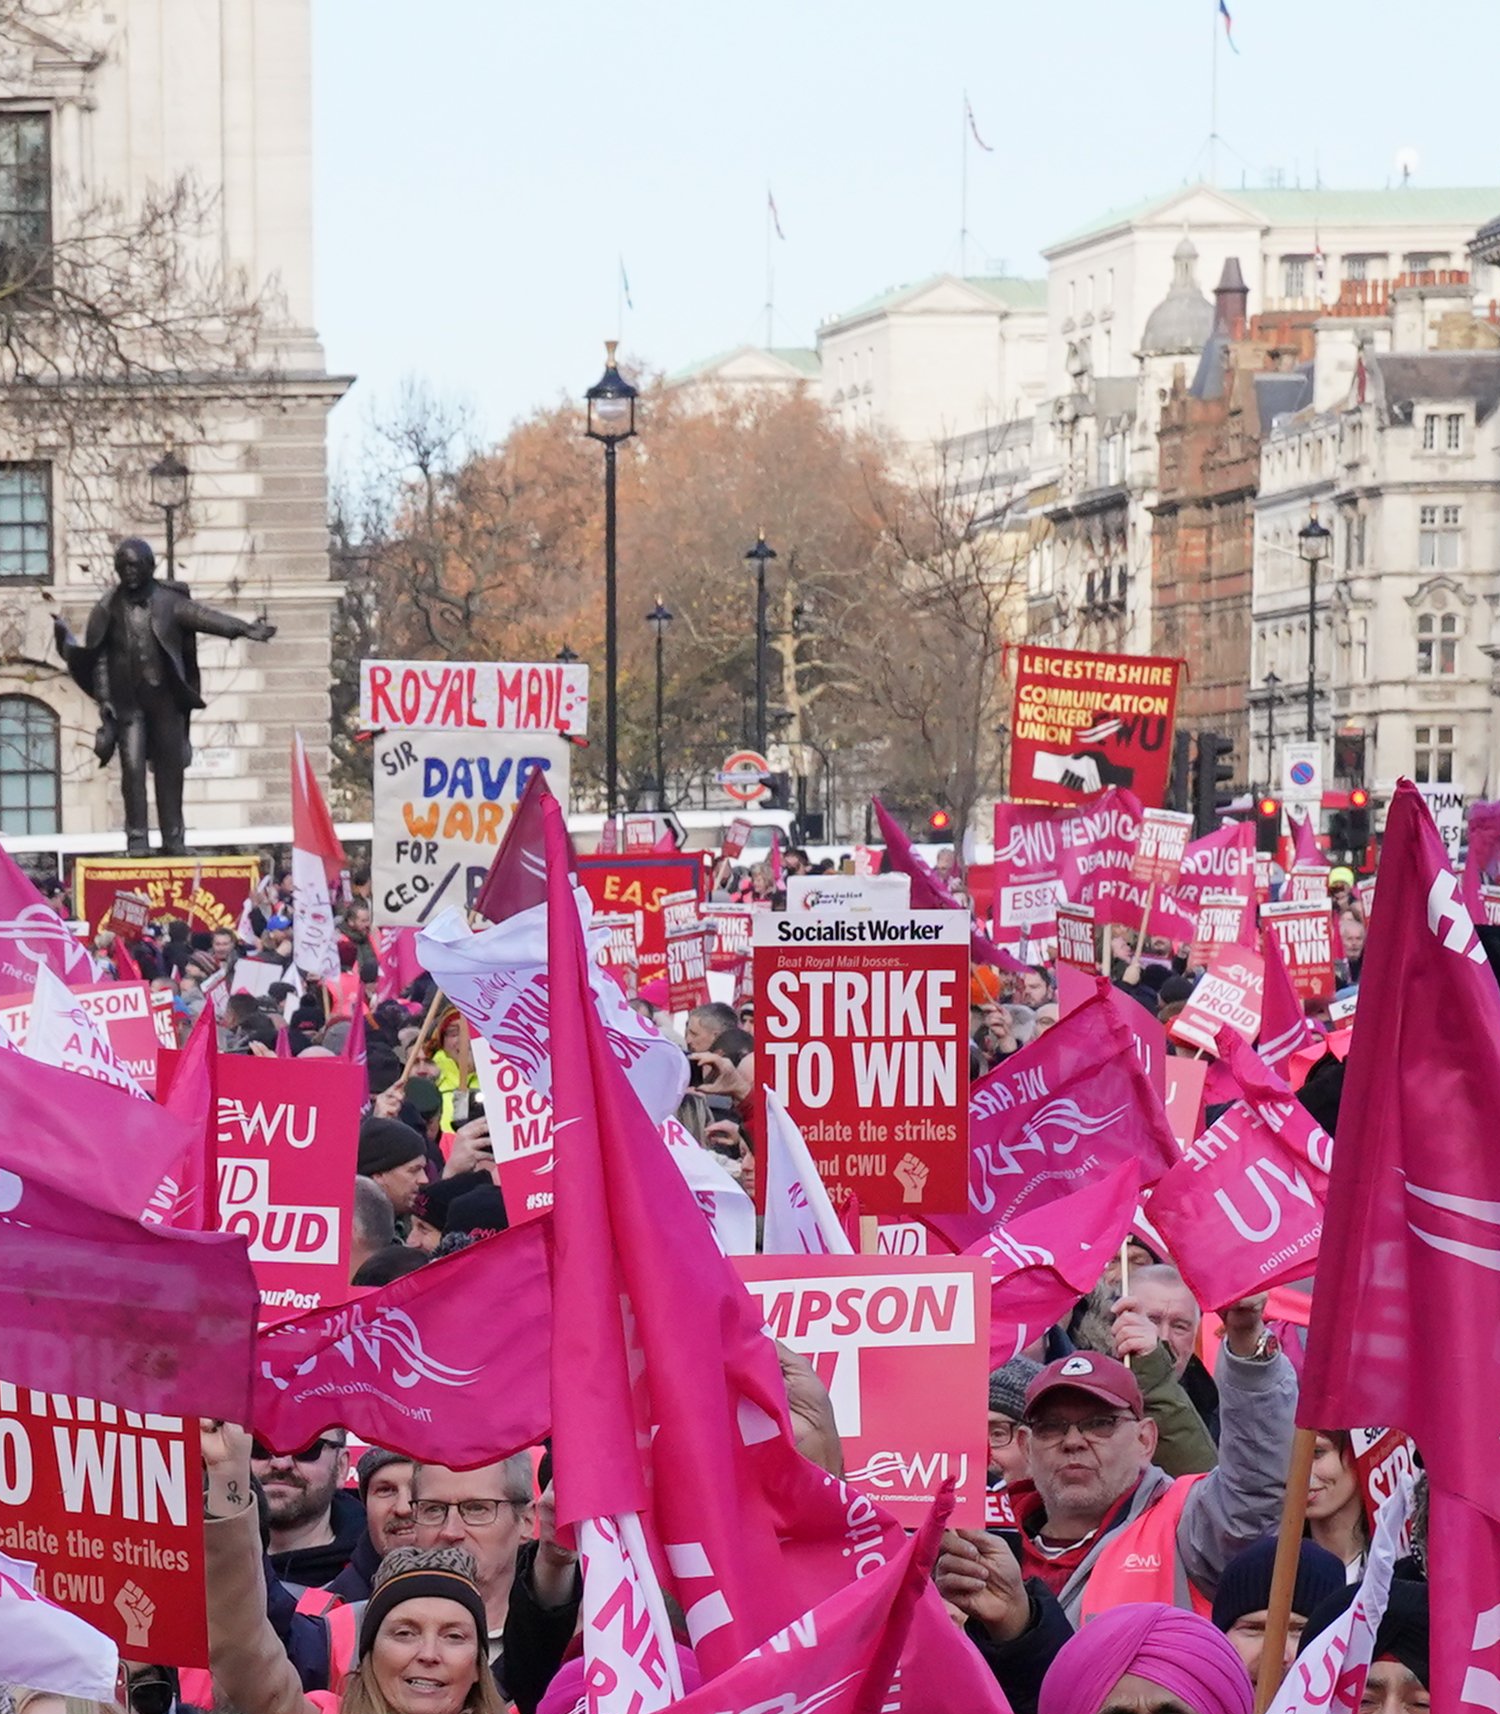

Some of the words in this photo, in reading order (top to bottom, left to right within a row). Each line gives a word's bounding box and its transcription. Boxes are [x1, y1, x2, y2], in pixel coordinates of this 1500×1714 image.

[1023, 656, 1173, 686] LEICESTERSHIRE
[369, 665, 486, 728] ROYAL
[497, 667, 571, 730] MAIL
[1019, 685, 1168, 716] COMMUNICATION
[1018, 704, 1093, 727] WORKERS
[1016, 721, 1072, 745] UNION
[381, 740, 418, 776] SIR
[423, 757, 551, 800] DAVE
[397, 841, 438, 865] FOR
[218, 868, 251, 878] UNION
[1011, 886, 1059, 909] ESSEX
[778, 921, 866, 941] Socialist
[869, 921, 943, 941] Worker
[778, 956, 802, 967] Beat
[805, 956, 834, 969] Royal
[838, 956, 858, 967] Mail
[766, 968, 957, 1037] STRIKE
[767, 1042, 833, 1109] TO
[847, 1039, 957, 1108] WIN
[54, 1424, 188, 1528] WIN
[1125, 1552, 1162, 1572] CWU
